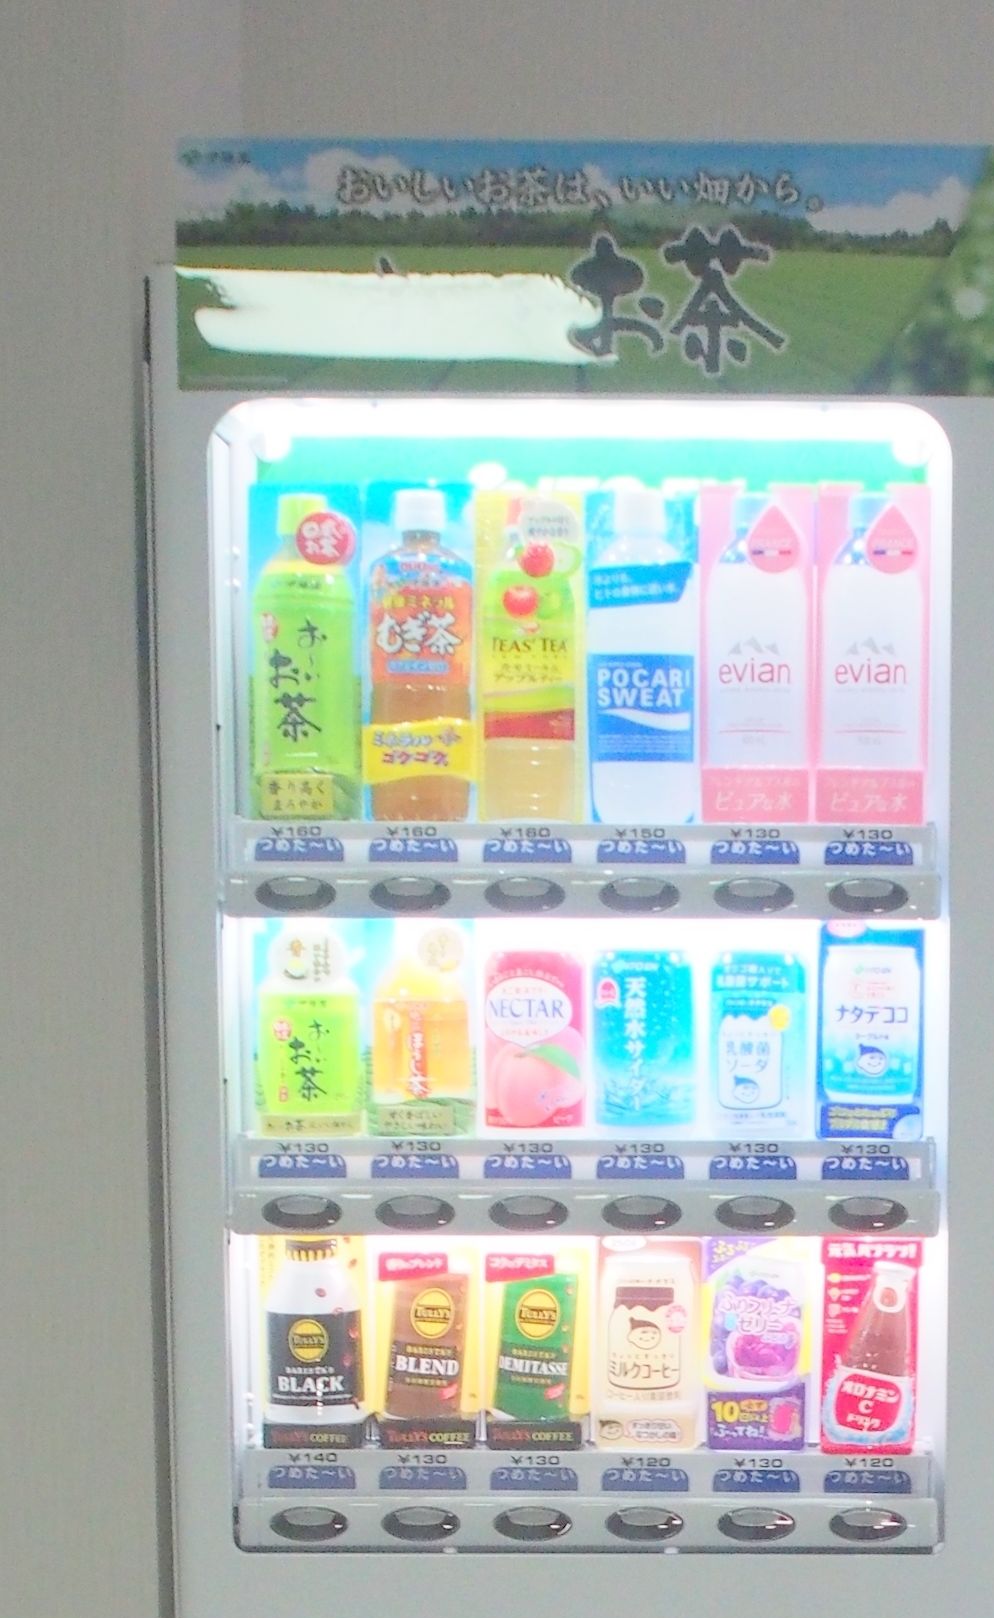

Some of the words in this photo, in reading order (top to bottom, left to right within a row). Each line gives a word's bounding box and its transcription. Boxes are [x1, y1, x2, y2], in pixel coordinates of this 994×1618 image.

[375, 610, 464, 656] むぎ茶
[541, 637, 568, 652] TEA
[718, 657, 791, 684] evian
[835, 657, 907, 685] evian
[597, 668, 690, 688] POCARI
[597, 688, 684, 708] SWEAT
[271, 826, 322, 837] ¥160
[387, 826, 437, 837] ¥160
[730, 828, 781, 839] ¥130
[843, 829, 893, 840] ¥130
[489, 999, 565, 1019] NECTAR
[278, 1142, 329, 1153] ¥130
[391, 1141, 441, 1152] ¥130
[503, 1142, 553, 1153] ¥130
[614, 1142, 665, 1153] ¥130
[728, 1142, 779, 1153] ¥130
[841, 1143, 891, 1154] ¥130
[395, 1355, 460, 1377] BLEND
[609, 1360, 679, 1379] ミルクコーヒー
[278, 1376, 344, 1392] BLACK
[712, 1400, 741, 1424] 10
[310, 1433, 348, 1443] COFFEE
[429, 1432, 471, 1442] COFFEE
[531, 1431, 574, 1442] COFFEE
[289, 1452, 338, 1463] ¥140
[398, 1453, 448, 1464] ¥130
[511, 1455, 560, 1465] ¥130
[622, 1456, 671, 1467] ¥120
[734, 1457, 783, 1468] ¥130
[845, 1457, 894, 1468] ¥120
